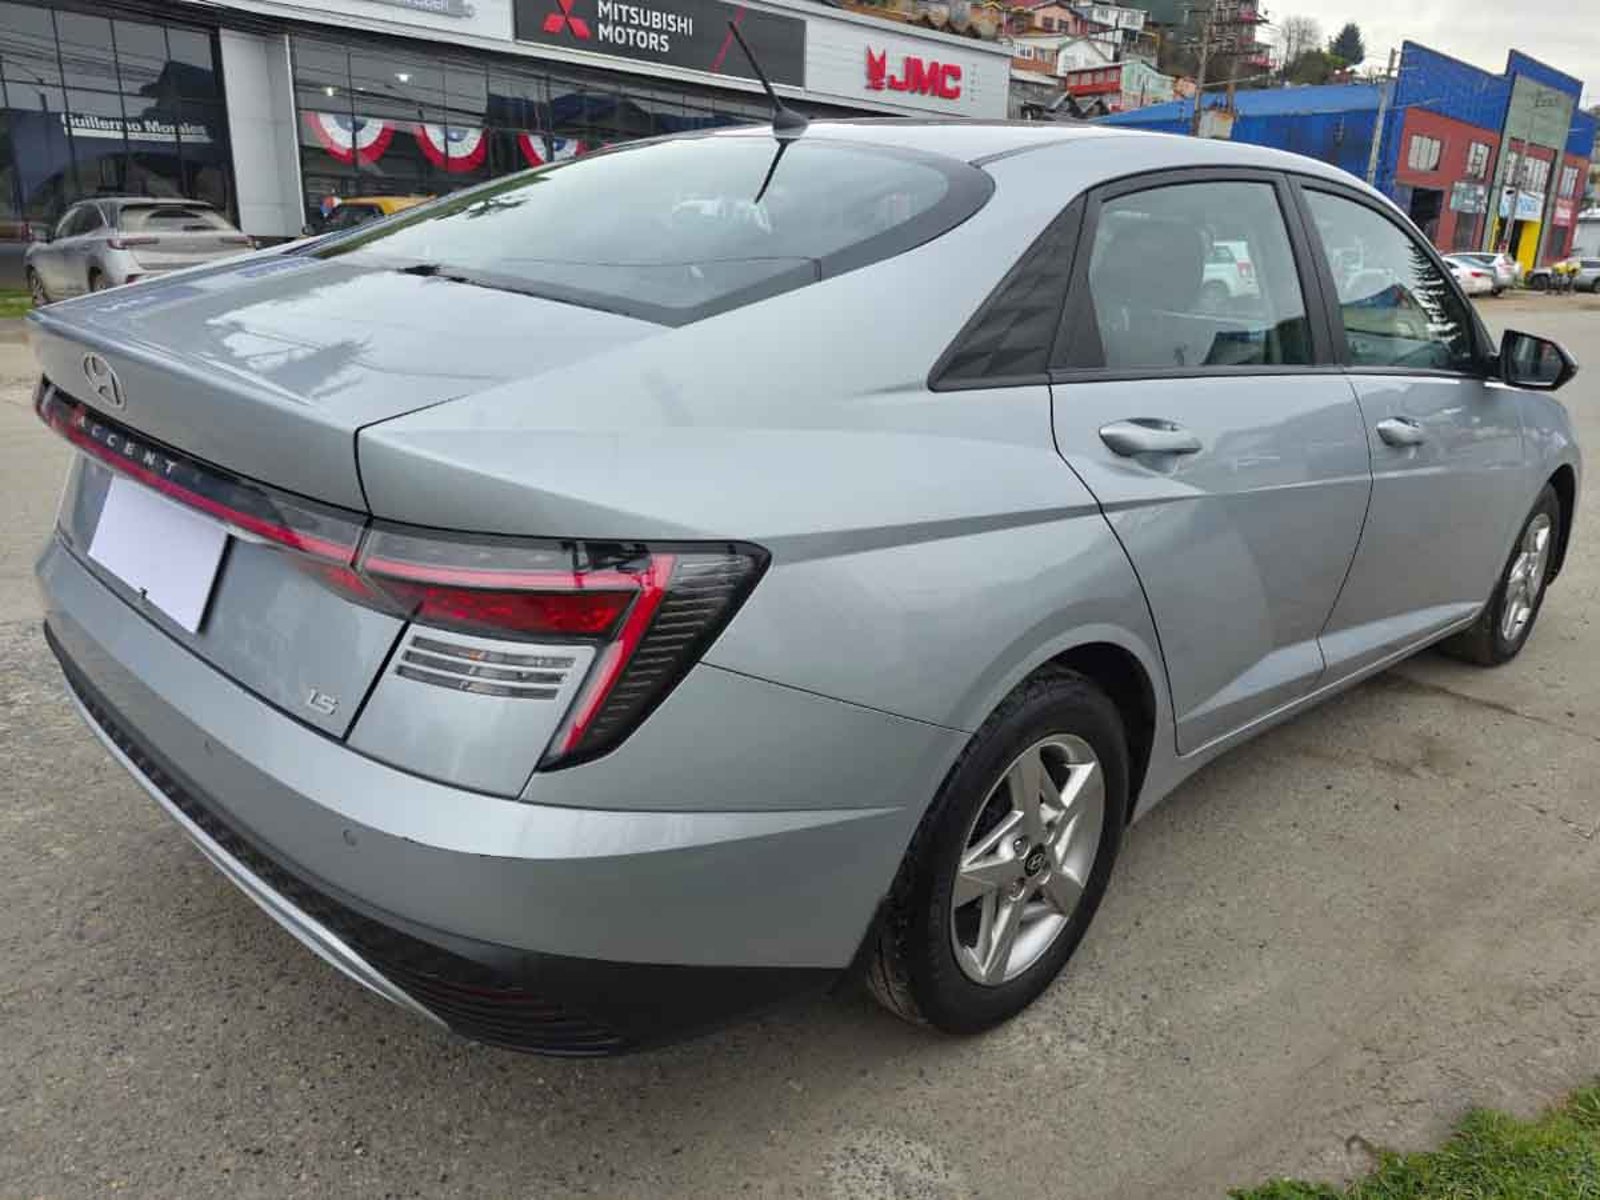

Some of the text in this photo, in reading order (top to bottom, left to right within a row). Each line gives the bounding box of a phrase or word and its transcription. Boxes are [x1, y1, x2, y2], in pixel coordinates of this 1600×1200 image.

[598, 0, 693, 36] MITSUBISHI
[598, 23, 669, 52] MOTORS
[887, 56, 962, 100] JMC
[74, 416, 178, 475] ACCENT
